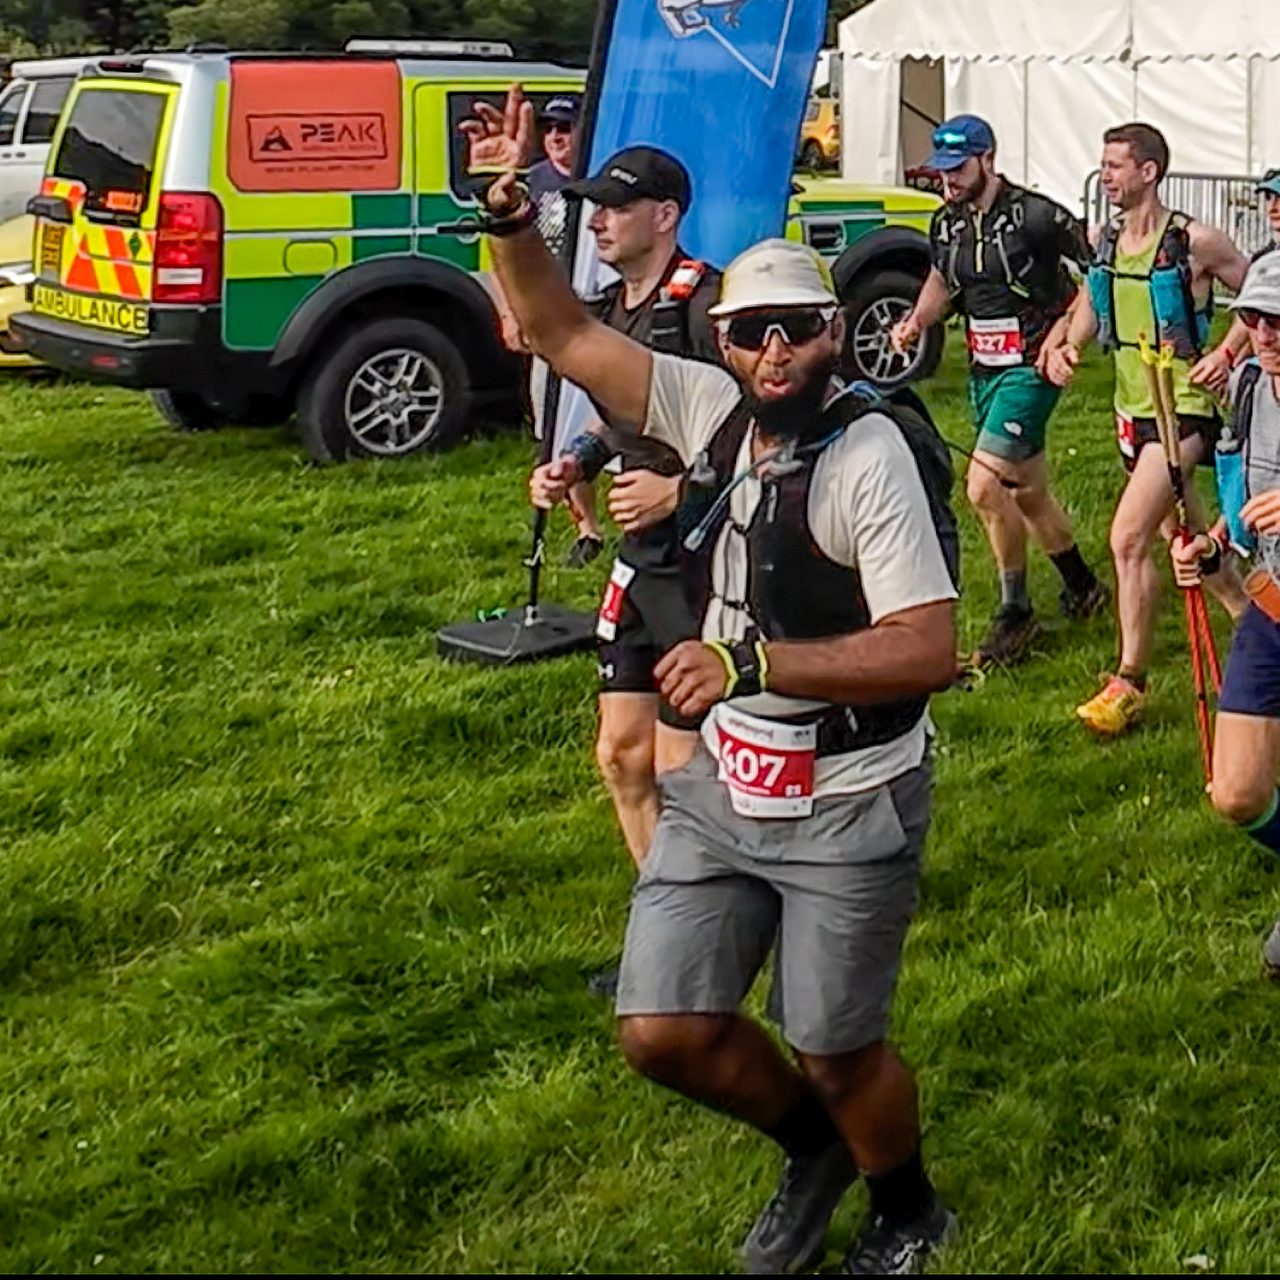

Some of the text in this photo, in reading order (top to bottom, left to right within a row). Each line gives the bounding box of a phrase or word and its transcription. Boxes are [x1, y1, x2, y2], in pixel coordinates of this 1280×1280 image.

[301, 123, 378, 143] PEAK
[35, 289, 148, 331] AMBULANCE
[721, 739, 786, 787] 407
